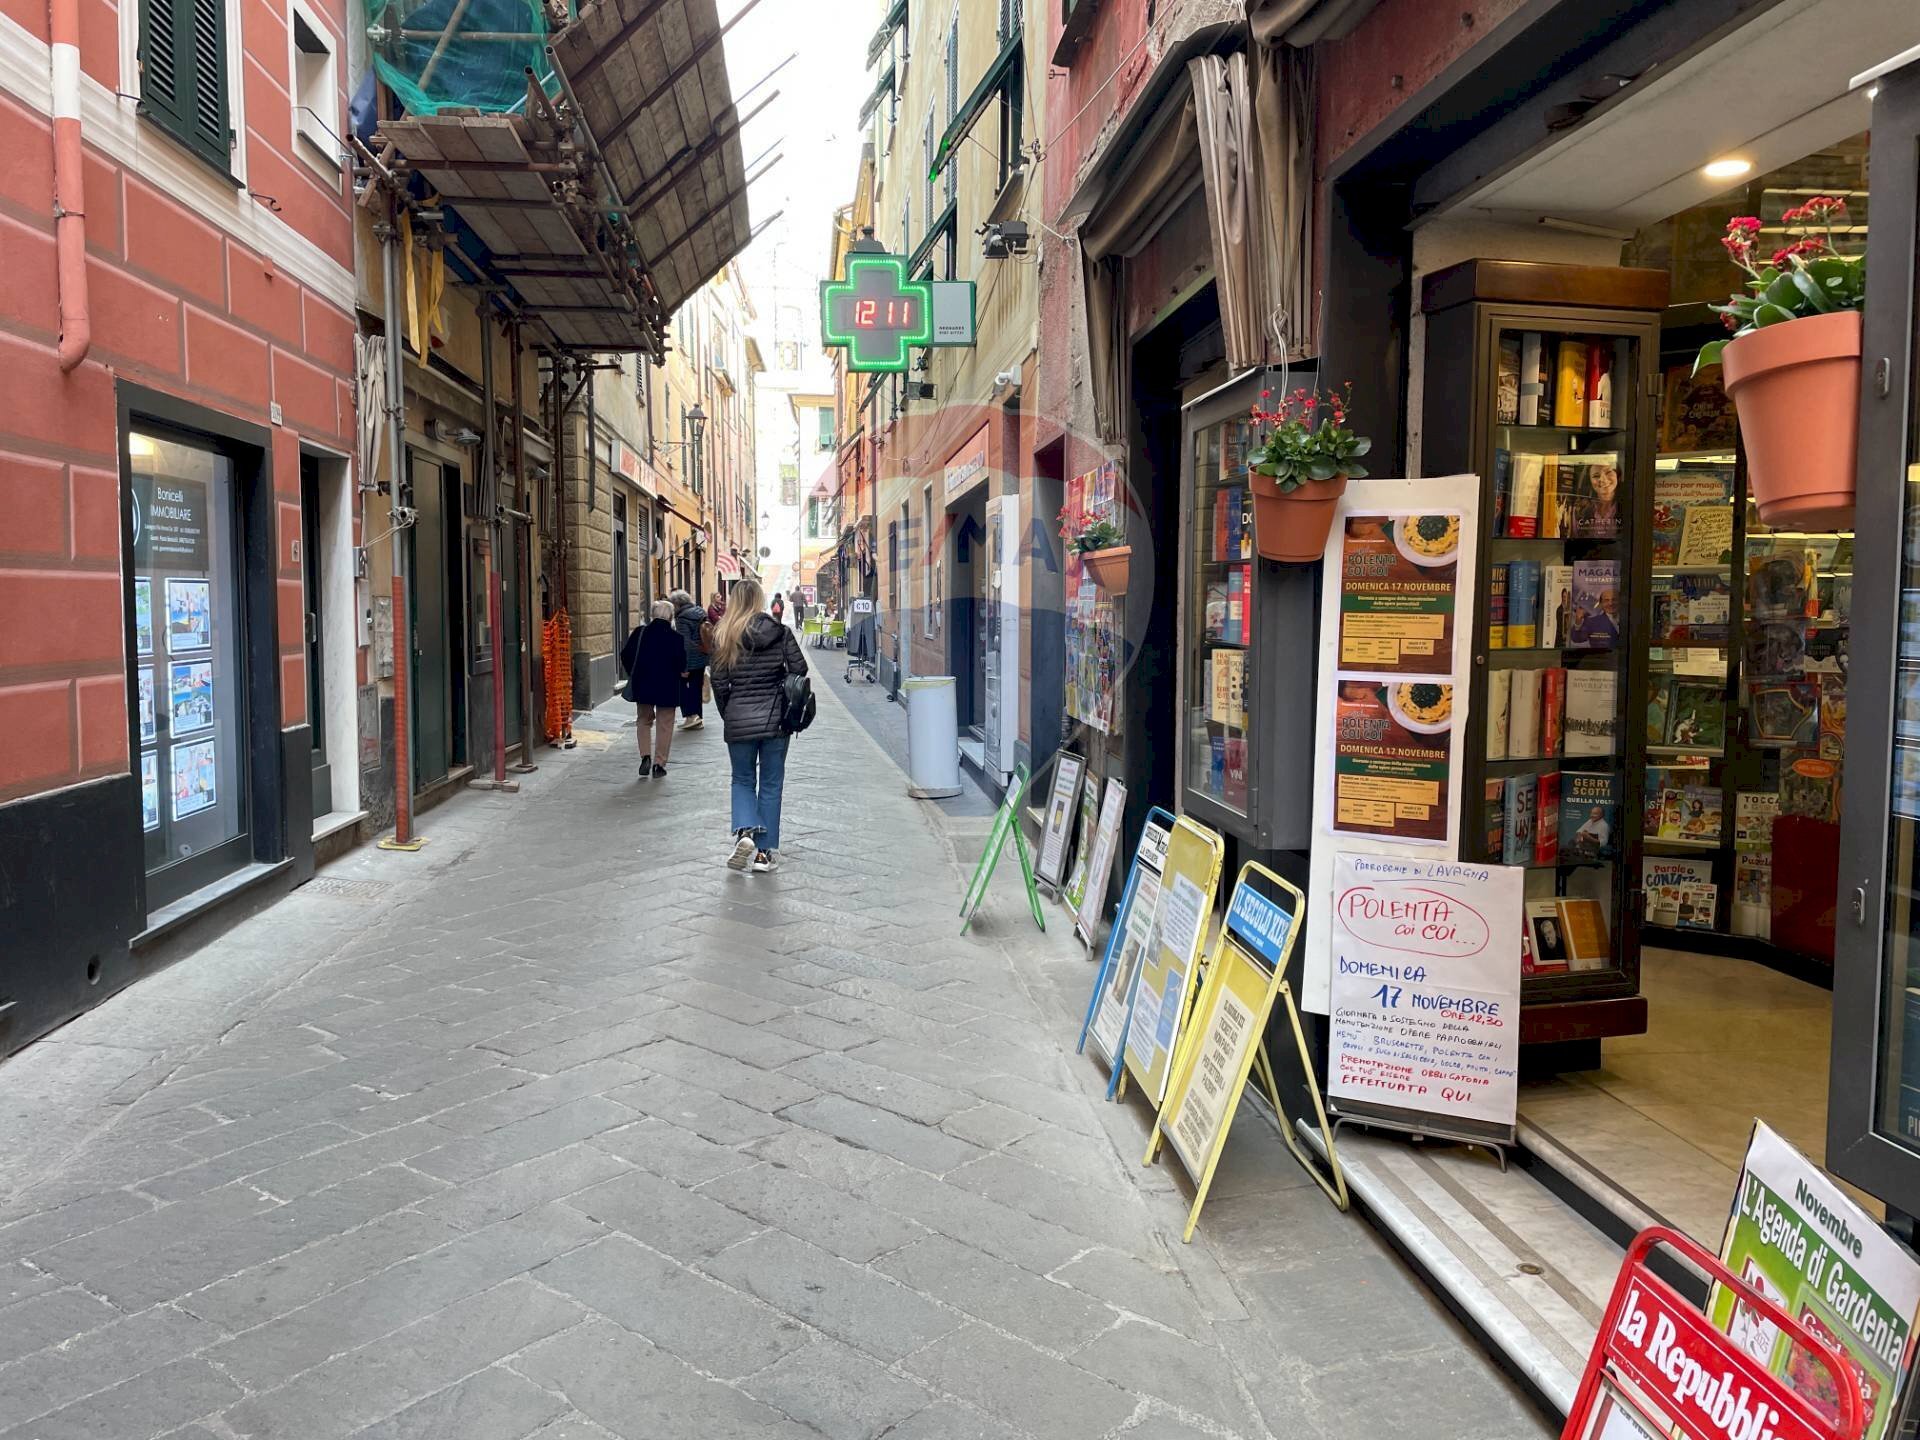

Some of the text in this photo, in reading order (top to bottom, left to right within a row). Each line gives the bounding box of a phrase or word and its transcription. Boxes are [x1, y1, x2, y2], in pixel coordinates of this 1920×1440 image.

[855, 300, 909, 325] 12 11
[157, 487, 184, 502] Bonicelli
[150, 504, 192, 521] IMMOBILIARE
[1347, 553, 1397, 566] POLENTA
[1345, 582, 1390, 591] DOMENICA
[1403, 583, 1452, 592] NOVEMBRE
[1341, 717, 1391, 730] POLENTA
[1340, 744, 1384, 755] DOMENICA
[1398, 748, 1446, 759] NOVEMBRE
[1572, 787, 1611, 797] SCOTTI
[1573, 777, 1611, 788] GERRY
[1427, 863, 1489, 881] LAVAGNA
[1654, 864, 1687, 874] Parole
[1350, 893, 1454, 922] POLENTA
[1232, 886, 1245, 916] IL
[1240, 892, 1274, 936] SECOLO
[1266, 911, 1290, 949] XIX
[1339, 955, 1427, 982] DOMENICA
[1371, 984, 1500, 1016] 17 NOVEMBRE
[1389, 1015, 1436, 1028] SOSTEGNO
[1442, 1022, 1469, 1032] DELLA
[1440, 1009, 1465, 1020] ORE
[1334, 1018, 1393, 1034] MANUTENZIONE
[1400, 1027, 1431, 1039] OPERE
[1340, 1053, 1490, 1086] PRENOTAZIONE OBBLIGATORIA
[1342, 1074, 1428, 1094] EFFETTUATA
[1907, 1114, 1920, 1137] PI
[1794, 1177, 1864, 1260] Novembre
[1741, 1174, 1807, 1271] L'Agenda
[1806, 1242, 1828, 1289] di
[1825, 1260, 1904, 1372] Gardenia
[1618, 1290, 1648, 1348] la
[1645, 1311, 1787, 1440] Repubbli
